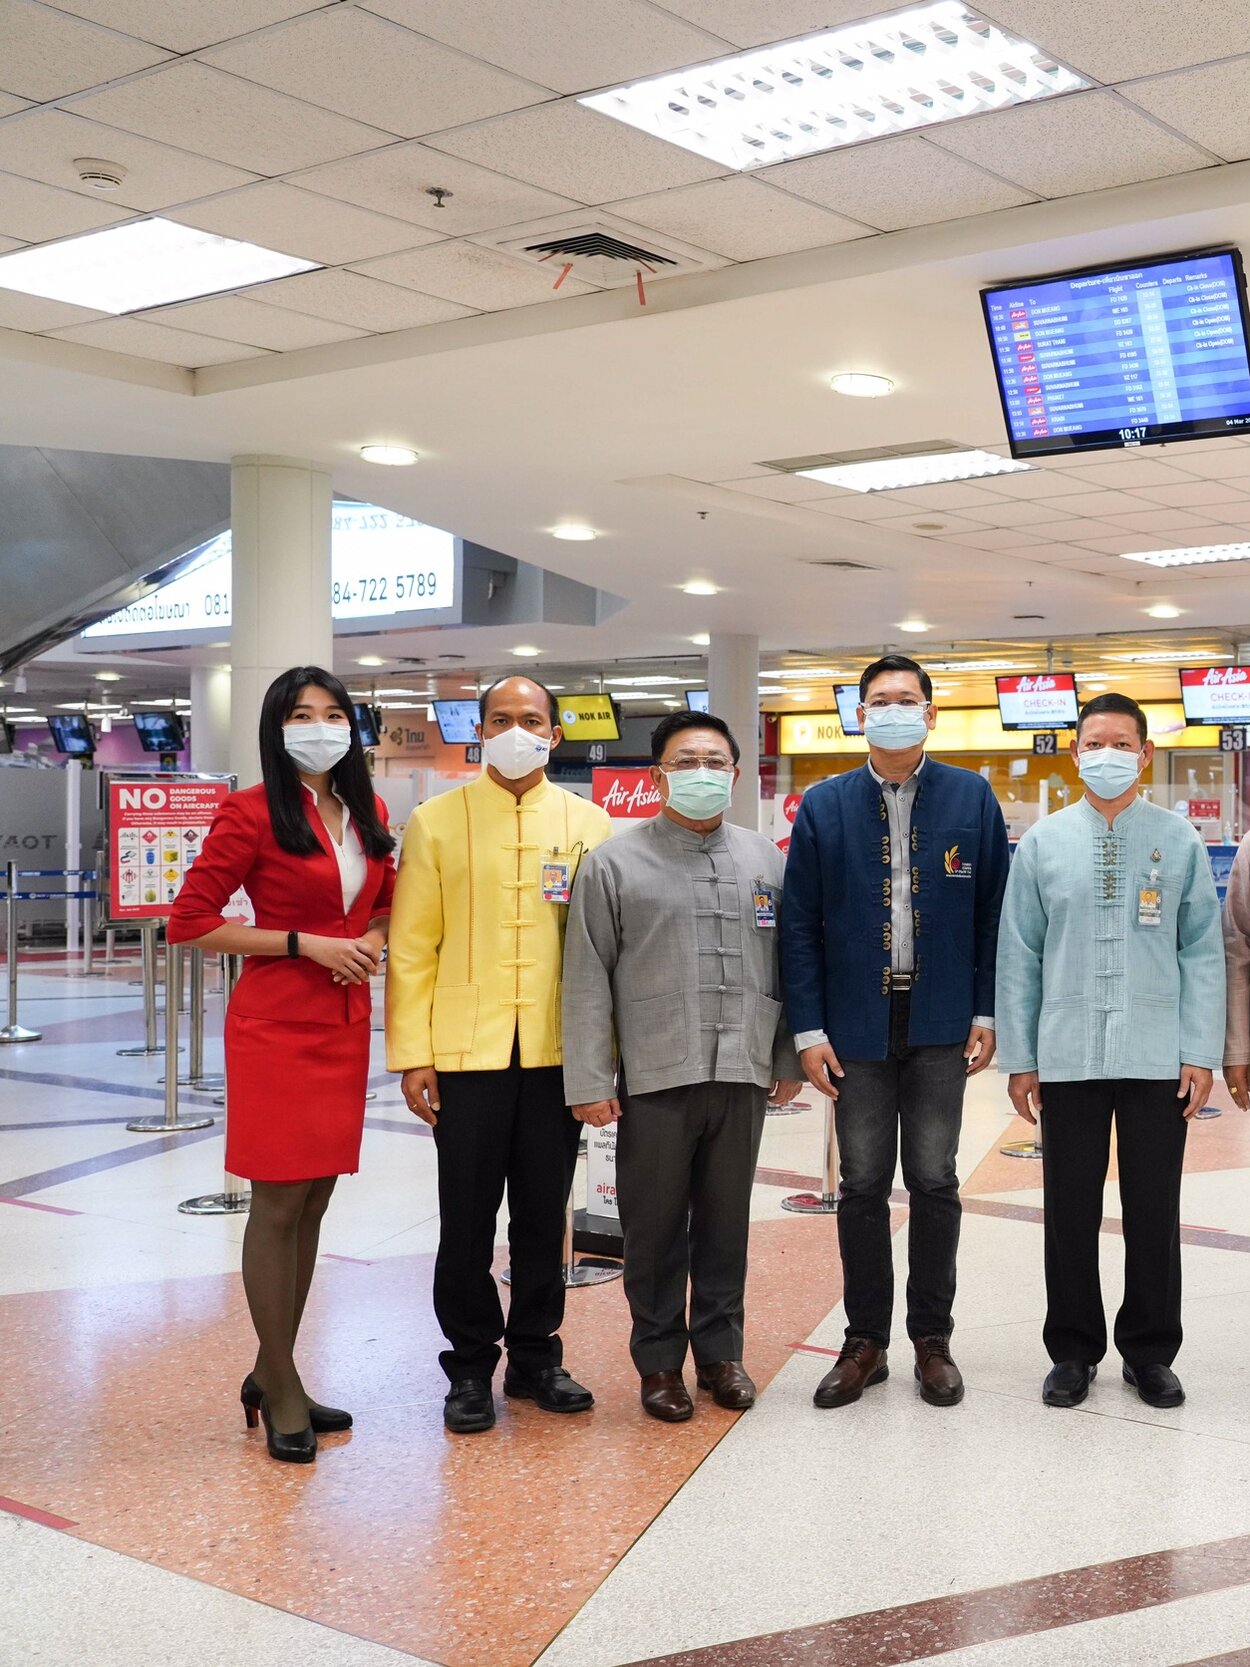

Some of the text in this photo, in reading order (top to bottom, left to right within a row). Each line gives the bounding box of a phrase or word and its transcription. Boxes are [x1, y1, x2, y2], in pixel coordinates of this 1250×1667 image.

[1108, 285, 1123, 294] Flight
[1135, 279, 1158, 289] Counters
[1184, 271, 1207, 281] Remarks
[1119, 427, 1147, 440] 10:17
[396, 572, 436, 598] 5789
[204, 593, 229, 616] 081
[1024, 699, 1066, 708] CHECK-IN
[598, 711, 612, 720] AIR
[817, 726, 841, 739] NOK
[1222, 731, 1244, 750] 53
[590, 744, 603, 760] 49
[1036, 735, 1054, 753] 52
[467, 748, 480, 763] 48
[119, 788, 167, 809] NO
[602, 779, 661, 813] AirAsia
[596, 1183, 616, 1195] aira
